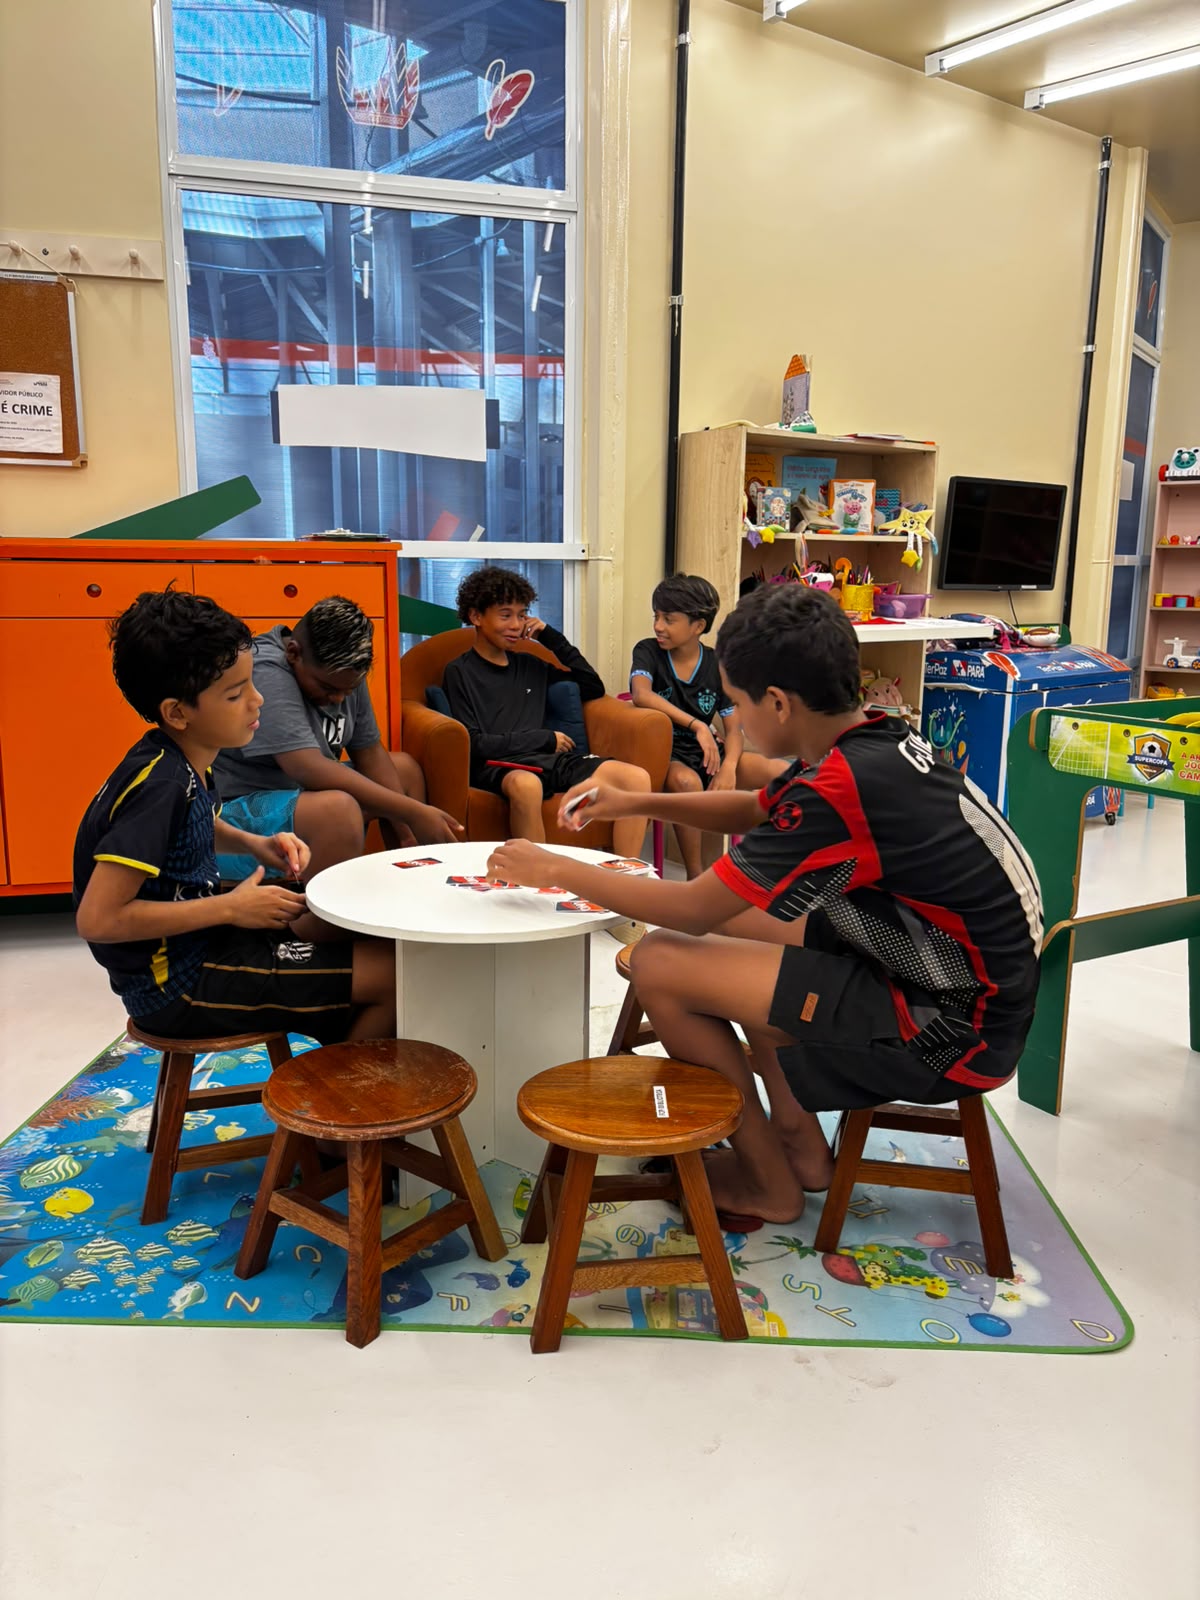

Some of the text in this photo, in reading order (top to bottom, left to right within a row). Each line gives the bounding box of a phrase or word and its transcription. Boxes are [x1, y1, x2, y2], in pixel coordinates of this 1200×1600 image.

[18, 390, 44, 398] PÚBLICO
[1, 400, 53, 417] É CRIME
[1134, 755, 1168, 766] SUPERCOPA
